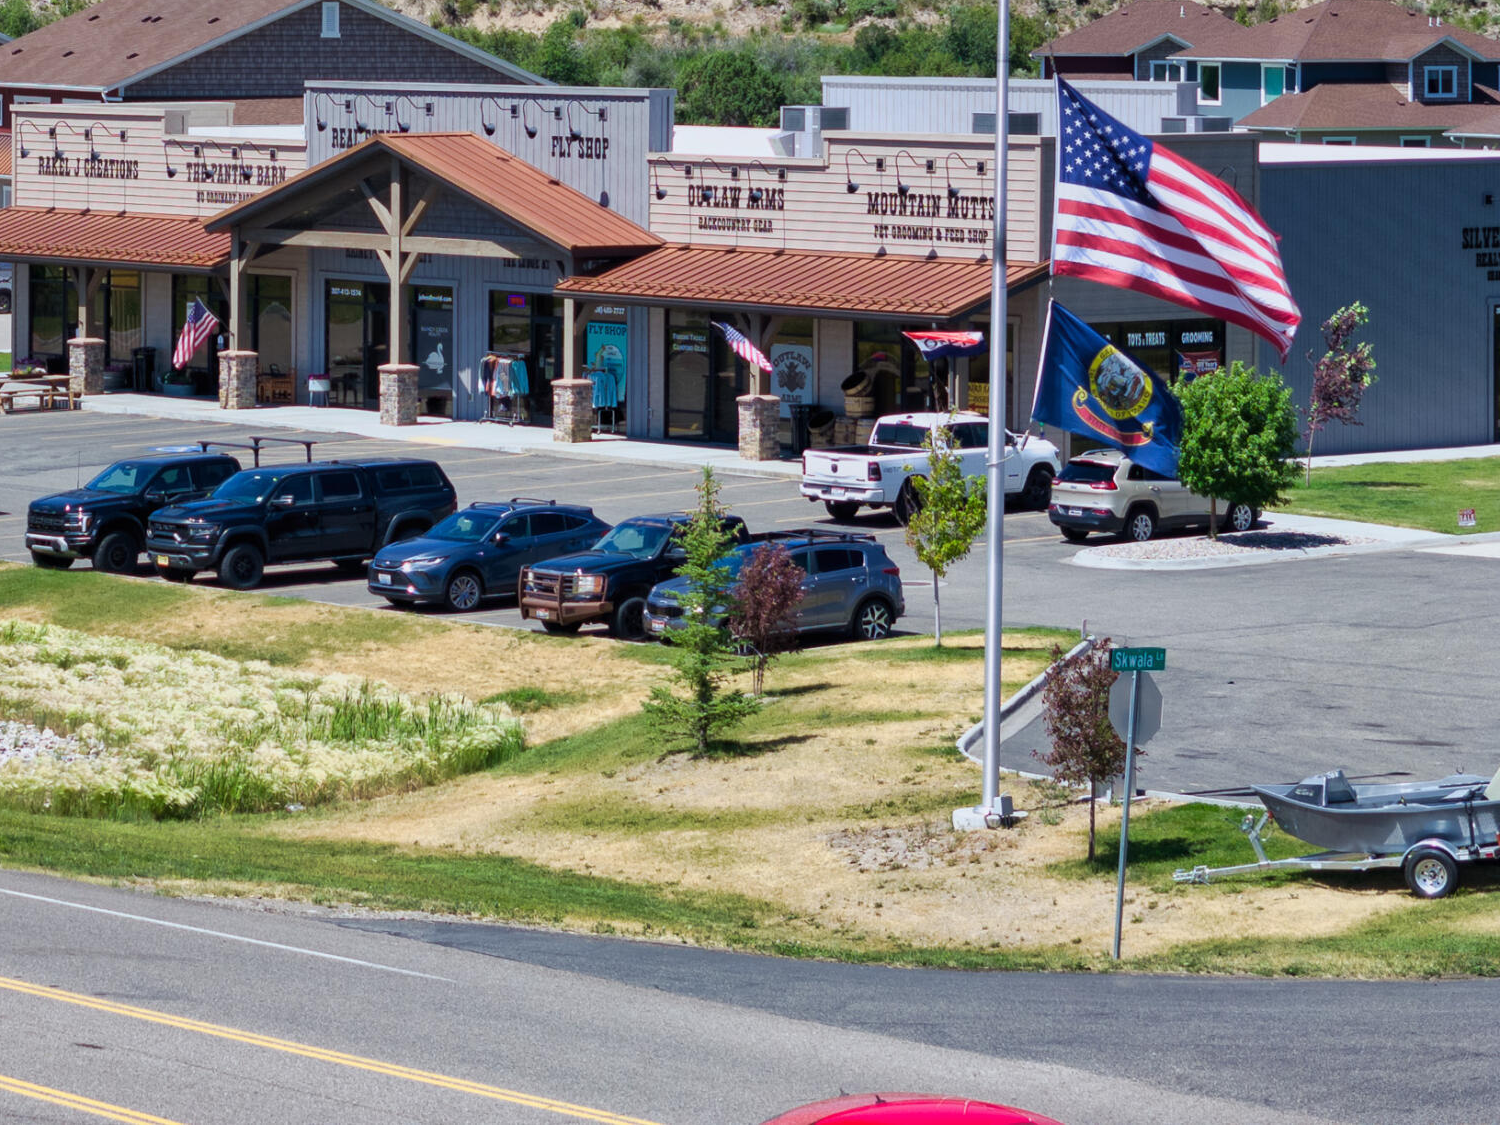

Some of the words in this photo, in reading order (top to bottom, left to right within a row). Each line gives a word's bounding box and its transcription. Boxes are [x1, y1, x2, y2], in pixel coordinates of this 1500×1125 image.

[331, 128, 359, 149] REAL
[551, 135, 573, 158] FLY
[578, 136, 609, 159] SHOP
[38, 156, 71, 176] RAKEL
[74, 157, 81, 177] J
[84, 158, 139, 179] CREATIONS
[186, 163, 207, 183] THE
[210, 163, 253, 185] PANTRY
[257, 165, 287, 186] BARN
[688, 184, 742, 209] OUTLAW
[746, 187, 785, 211] ARMS
[867, 192, 941, 217] MOUNTAIN
[947, 196, 995, 220] MUTTS
[698, 216, 751, 233] BACKCOUNTRY
[753, 219, 774, 233] GEAR
[874, 225, 889, 238] PET
[891, 226, 934, 241] GROOMING
[936, 227, 943, 241] &
[945, 228, 965, 243] FEED
[967, 229, 989, 244] SHOP
[588, 324, 603, 335] FLY
[604, 325, 627, 336] SHOP
[1127, 332, 1142, 347] TOYS
[1145, 332, 1166, 346] TREATS
[1181, 331, 1214, 344] GROOMING
[773, 350, 812, 370] OUTLAW
[1114, 651, 1154, 668] Skwala
